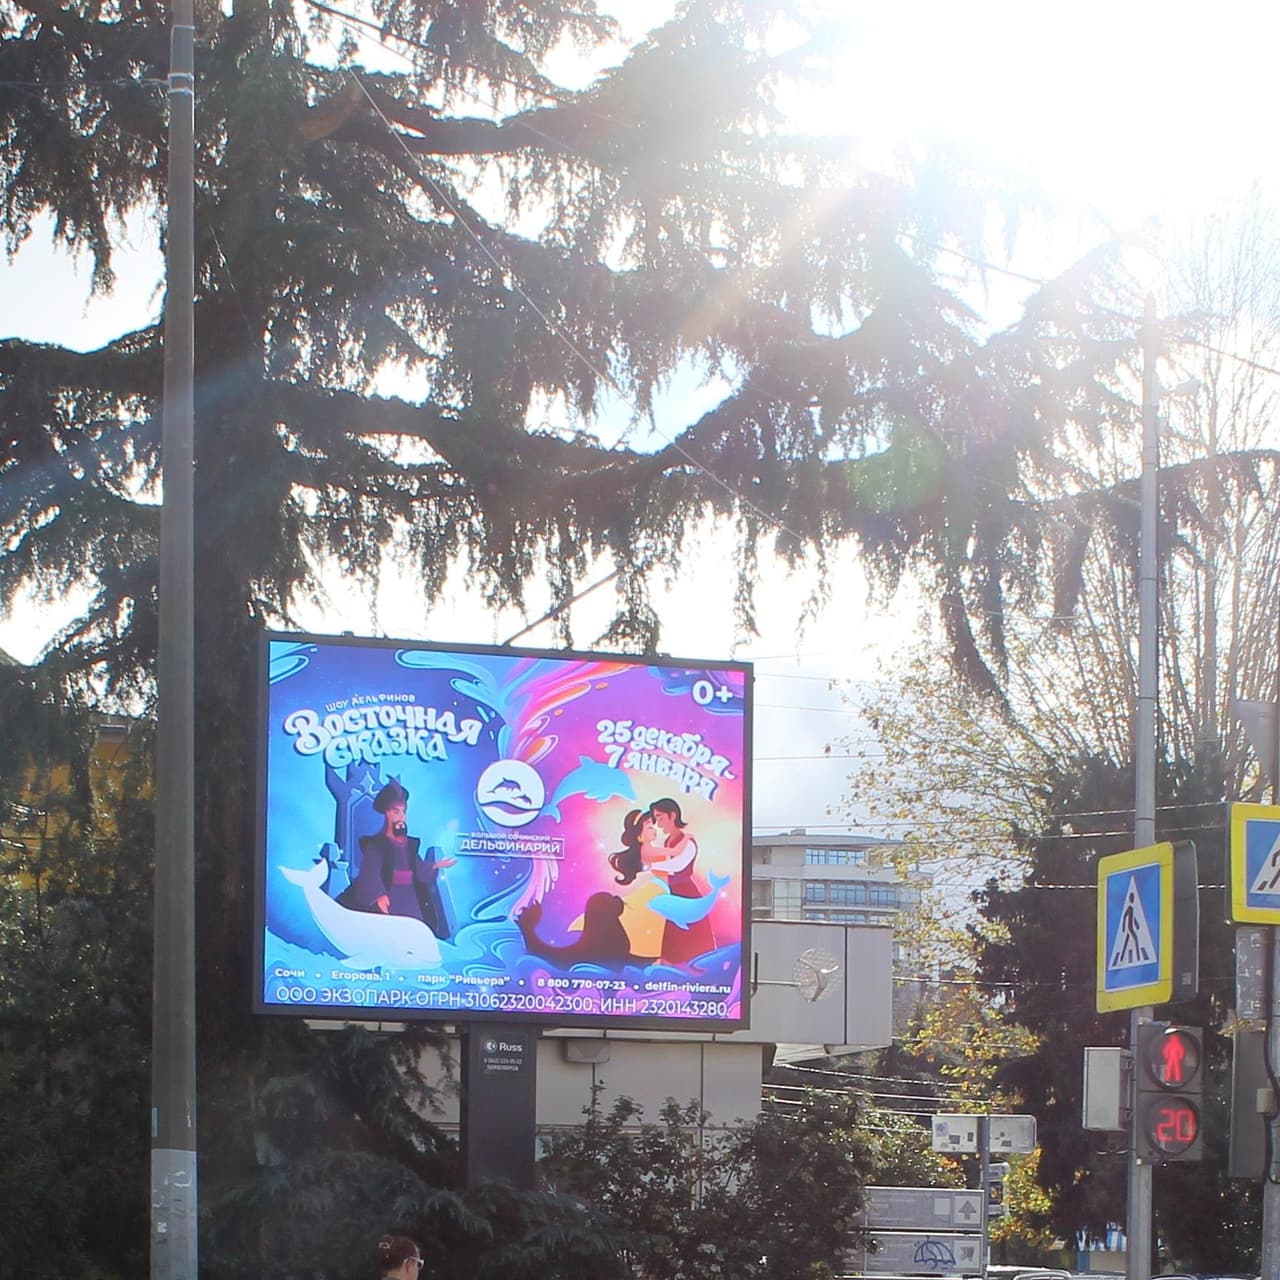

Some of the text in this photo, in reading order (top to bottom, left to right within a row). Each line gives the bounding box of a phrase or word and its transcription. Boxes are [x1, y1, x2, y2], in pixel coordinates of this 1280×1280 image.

[325, 693, 417, 712] ШОУ ДЕЛЬФИНОВ
[692, 680, 734, 705] 0+
[283, 704, 484, 757] Восточная
[596, 719, 634, 744] 25
[604, 744, 719, 802] 7 января
[460, 839, 561, 854] ДЕЛЬФИНАРИЙ
[275, 968, 305, 978] Сочи
[417, 974, 446, 985] парк
[537, 978, 546, 988] 8
[548, 978, 570, 988] 800
[571, 979, 626, 990] 770-07-23
[645, 981, 731, 994] delfin-riviera.ru
[276, 986, 317, 1002] ООО
[320, 988, 411, 1005] ЭКЗОПАРК
[416, 991, 461, 1007] ОГРН
[600, 998, 637, 1013] ИНН
[499, 1042, 523, 1052] Russ
[1156, 1109, 1197, 1143] 20
